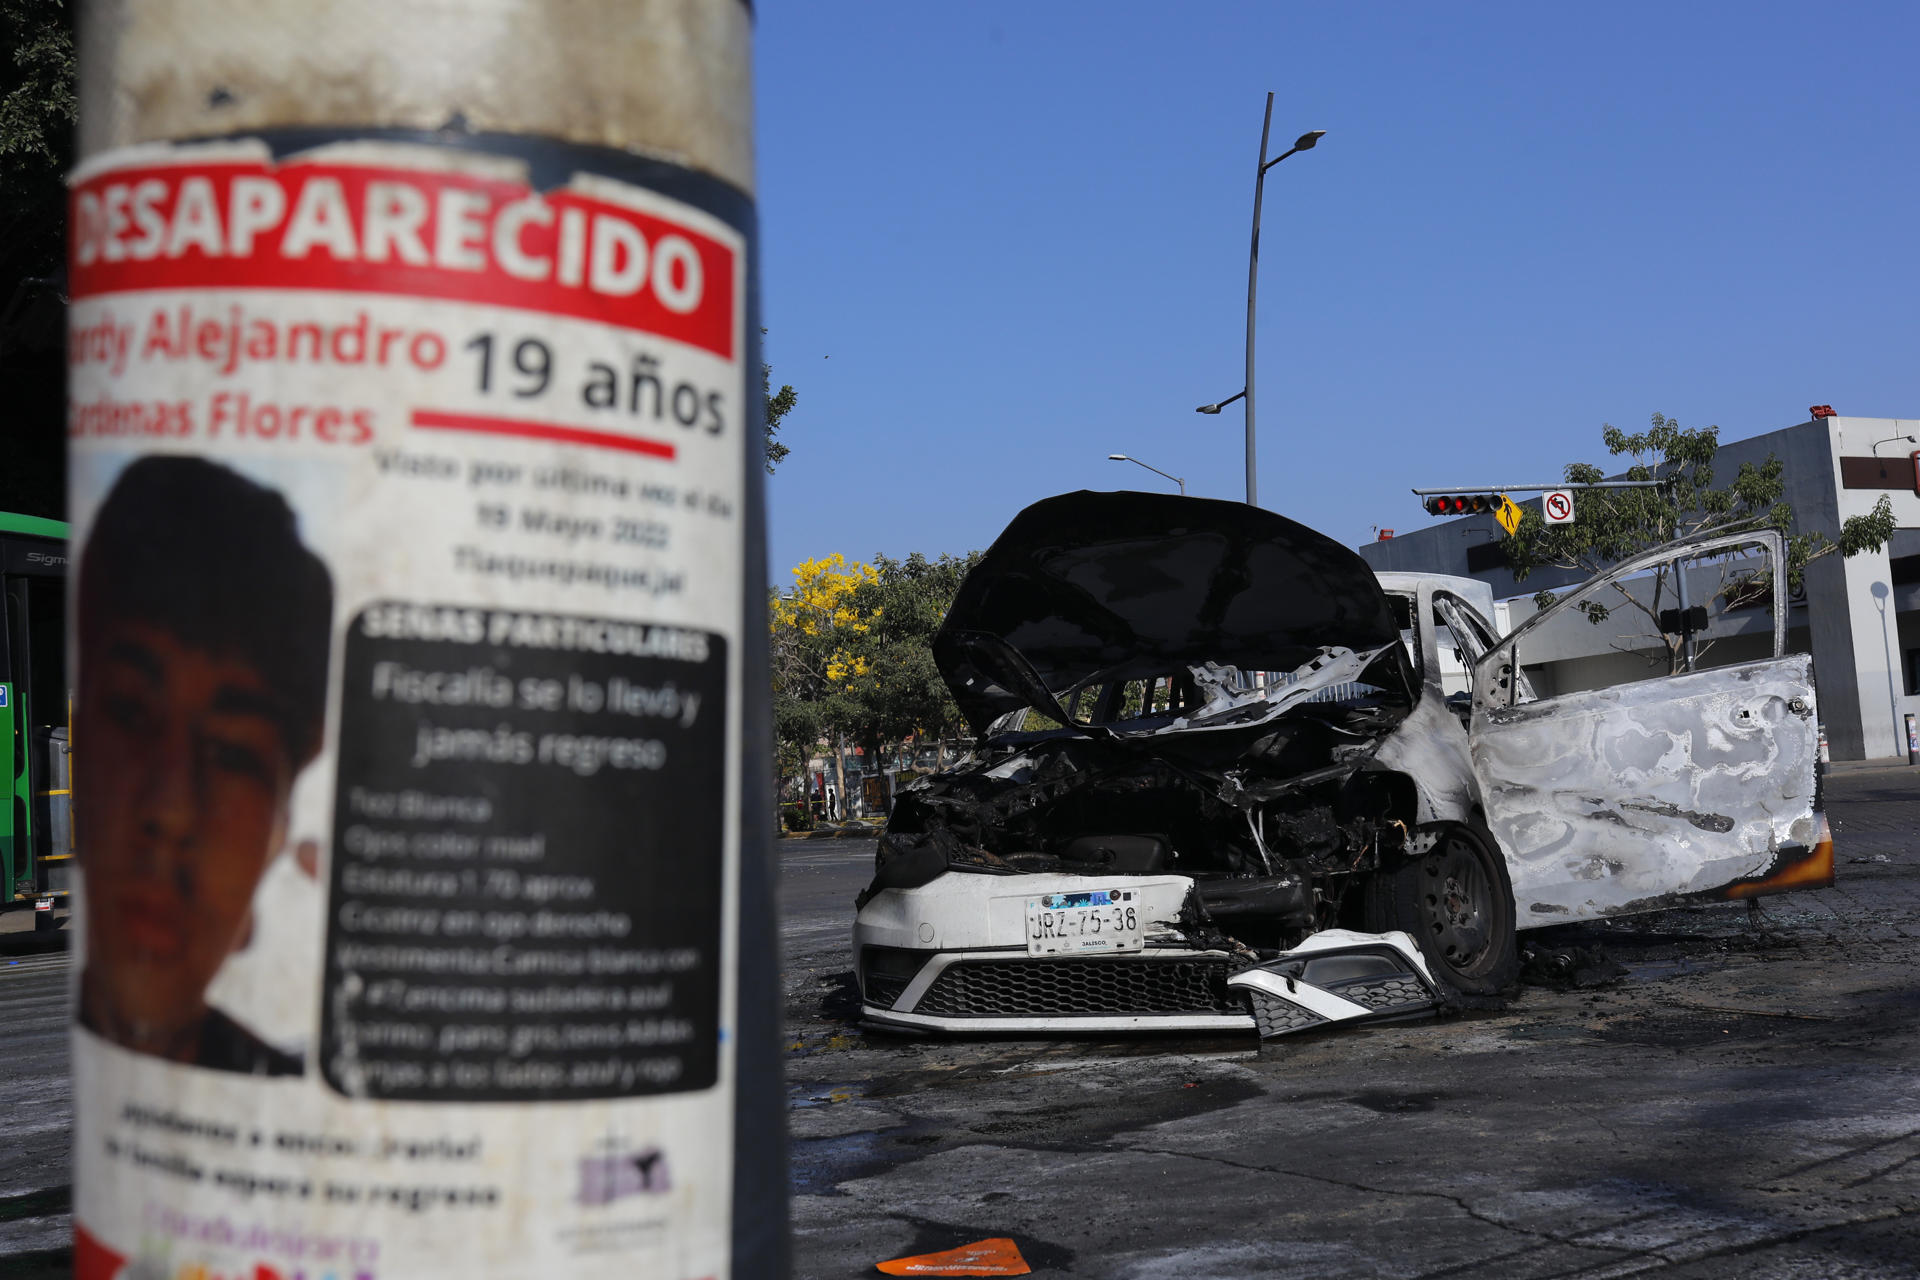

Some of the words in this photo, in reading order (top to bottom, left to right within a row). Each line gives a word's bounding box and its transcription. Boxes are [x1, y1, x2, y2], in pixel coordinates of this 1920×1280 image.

[76, 176, 704, 313] DESAPARECIDO
[142, 303, 447, 376] Alejandro
[464, 331, 552, 399] 19
[582, 355, 726, 438] años
[208, 392, 375, 445] Flores
[468, 461, 525, 489] por
[520, 508, 603, 543] Mayo
[489, 616, 710, 661] PARTICULARES
[520, 678, 562, 709] se
[570, 676, 603, 712] lo
[540, 736, 665, 774] regreso
[1032, 907, 1136, 939] JRZ-75-38
